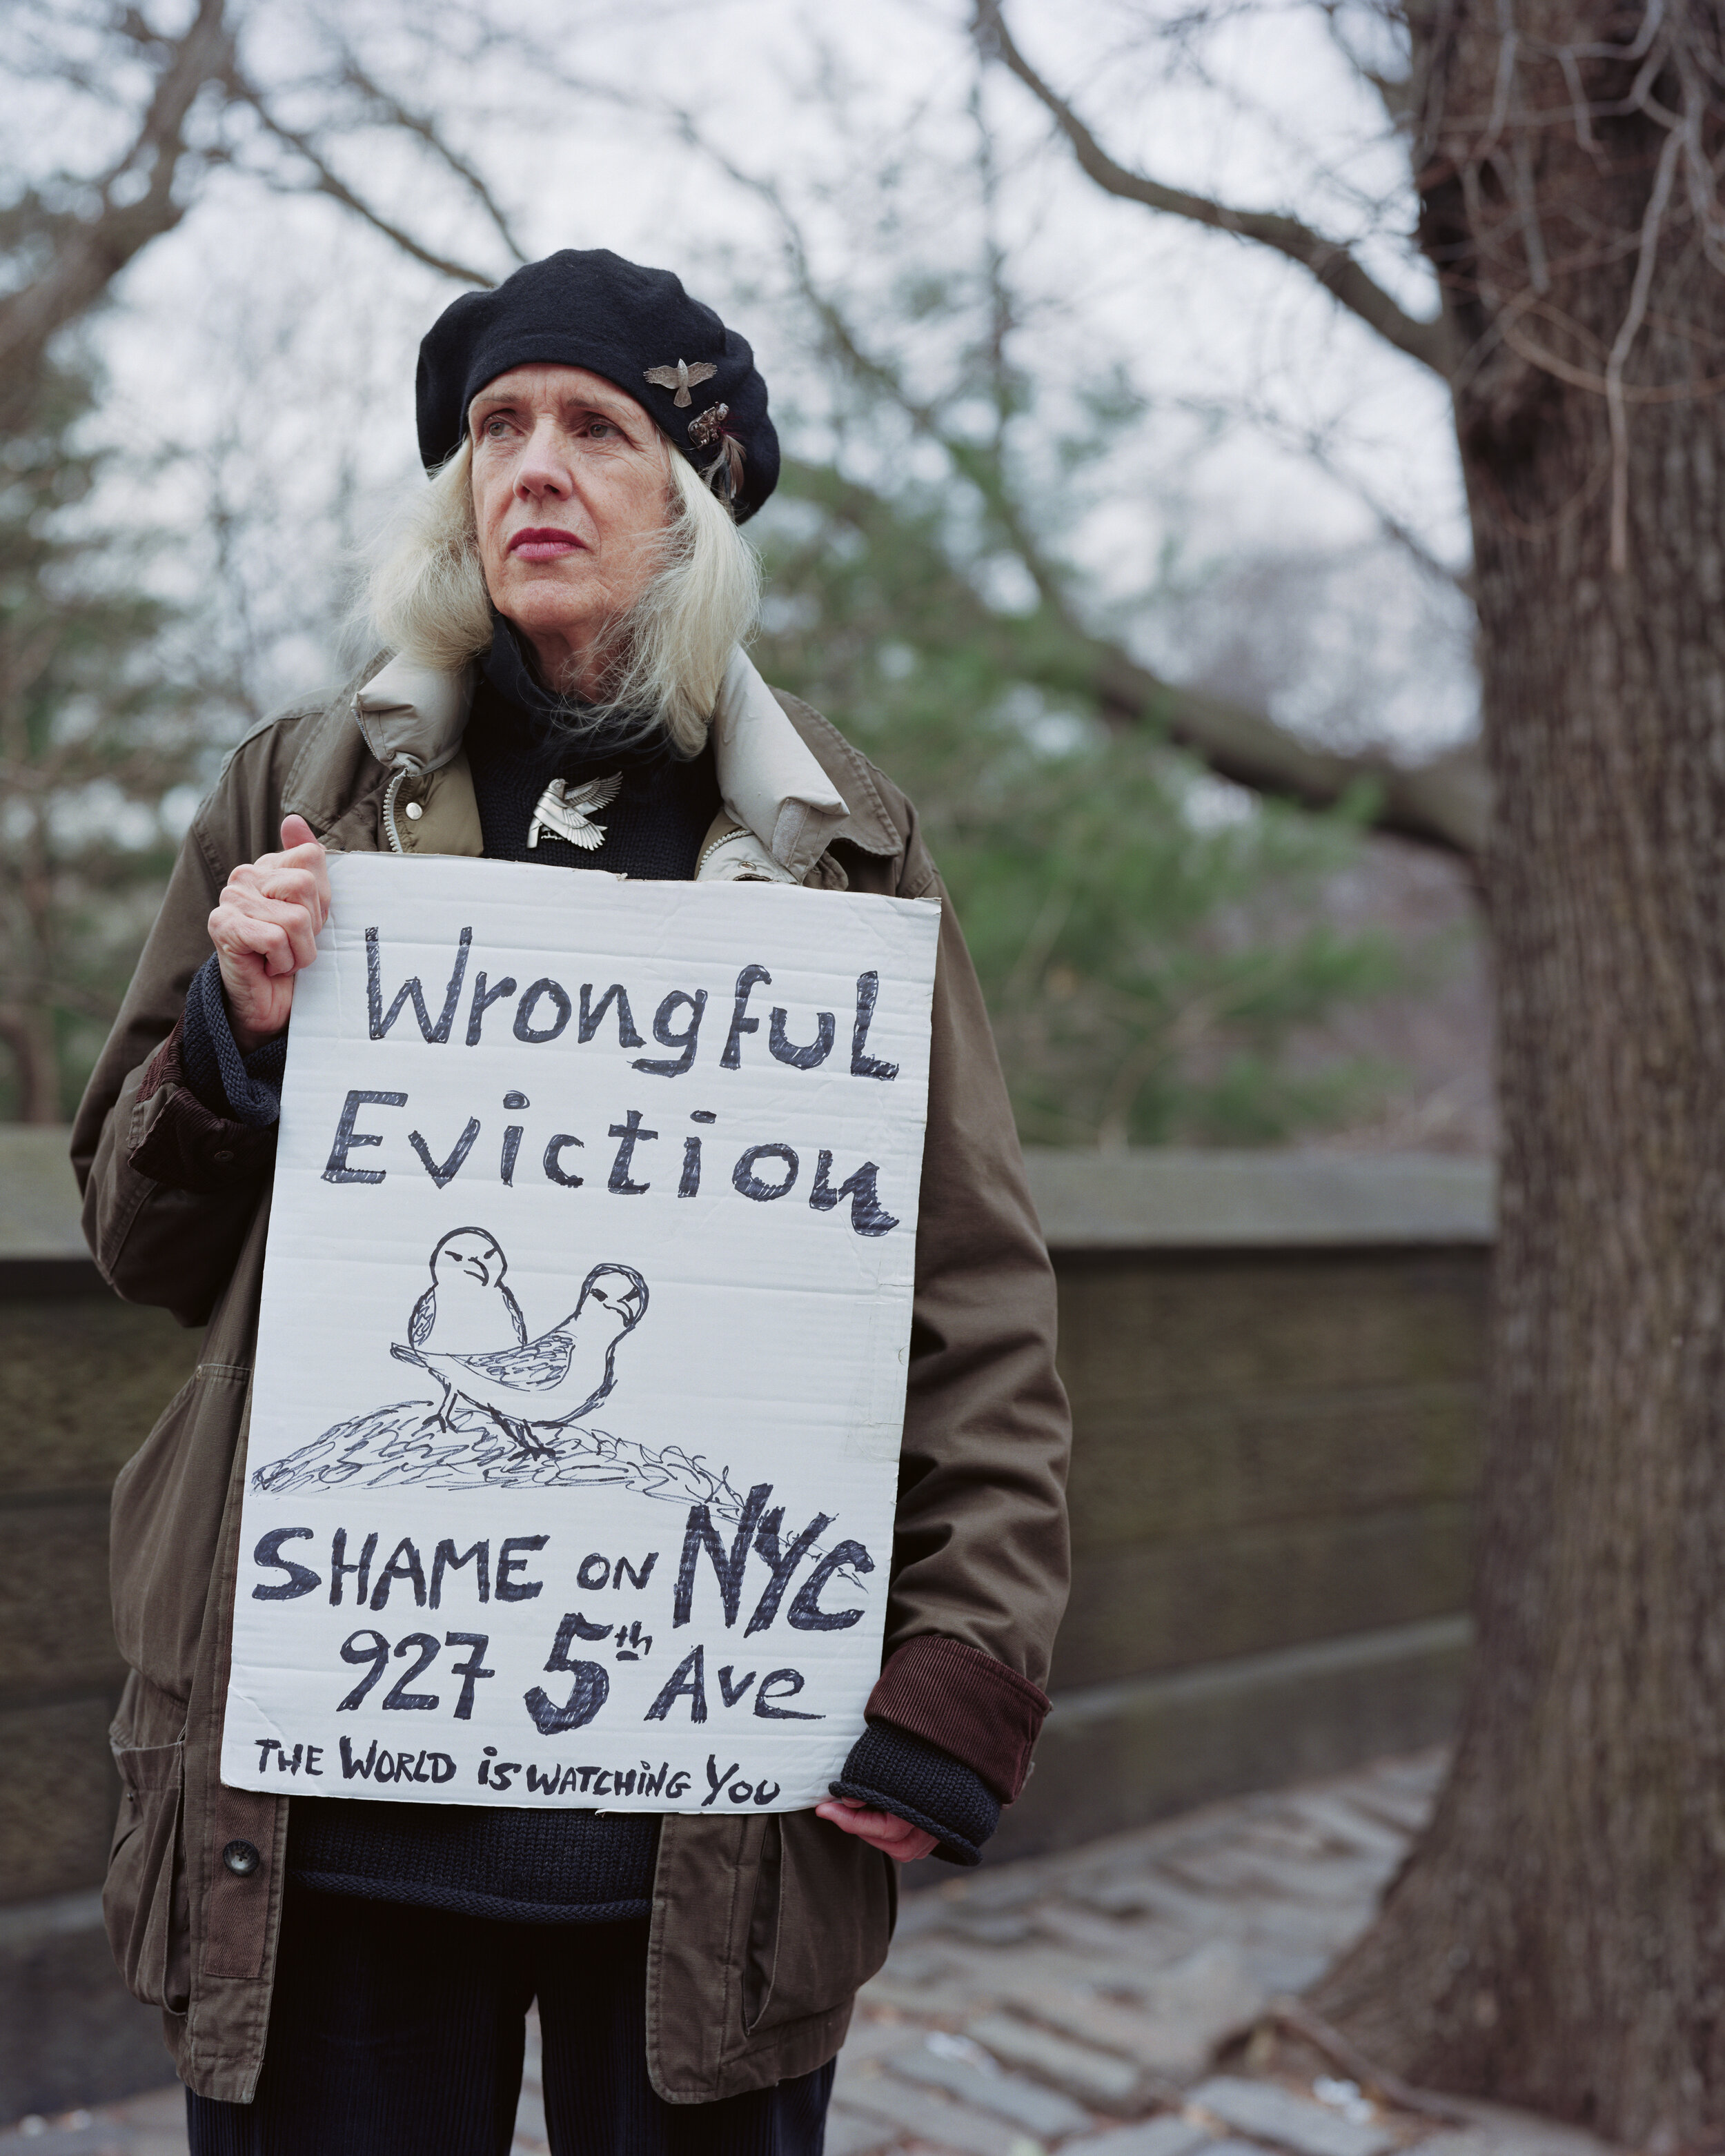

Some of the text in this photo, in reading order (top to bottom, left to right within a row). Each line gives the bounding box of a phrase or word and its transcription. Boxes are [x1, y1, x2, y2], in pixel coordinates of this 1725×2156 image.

[321, 1089, 900, 1237] Eviction
[252, 1483, 876, 1638] SHAME ON NYC
[336, 1612, 827, 1737] 927 5th Ave
[254, 1738, 324, 1777] THE
[339, 1735, 456, 1785] WORLD
